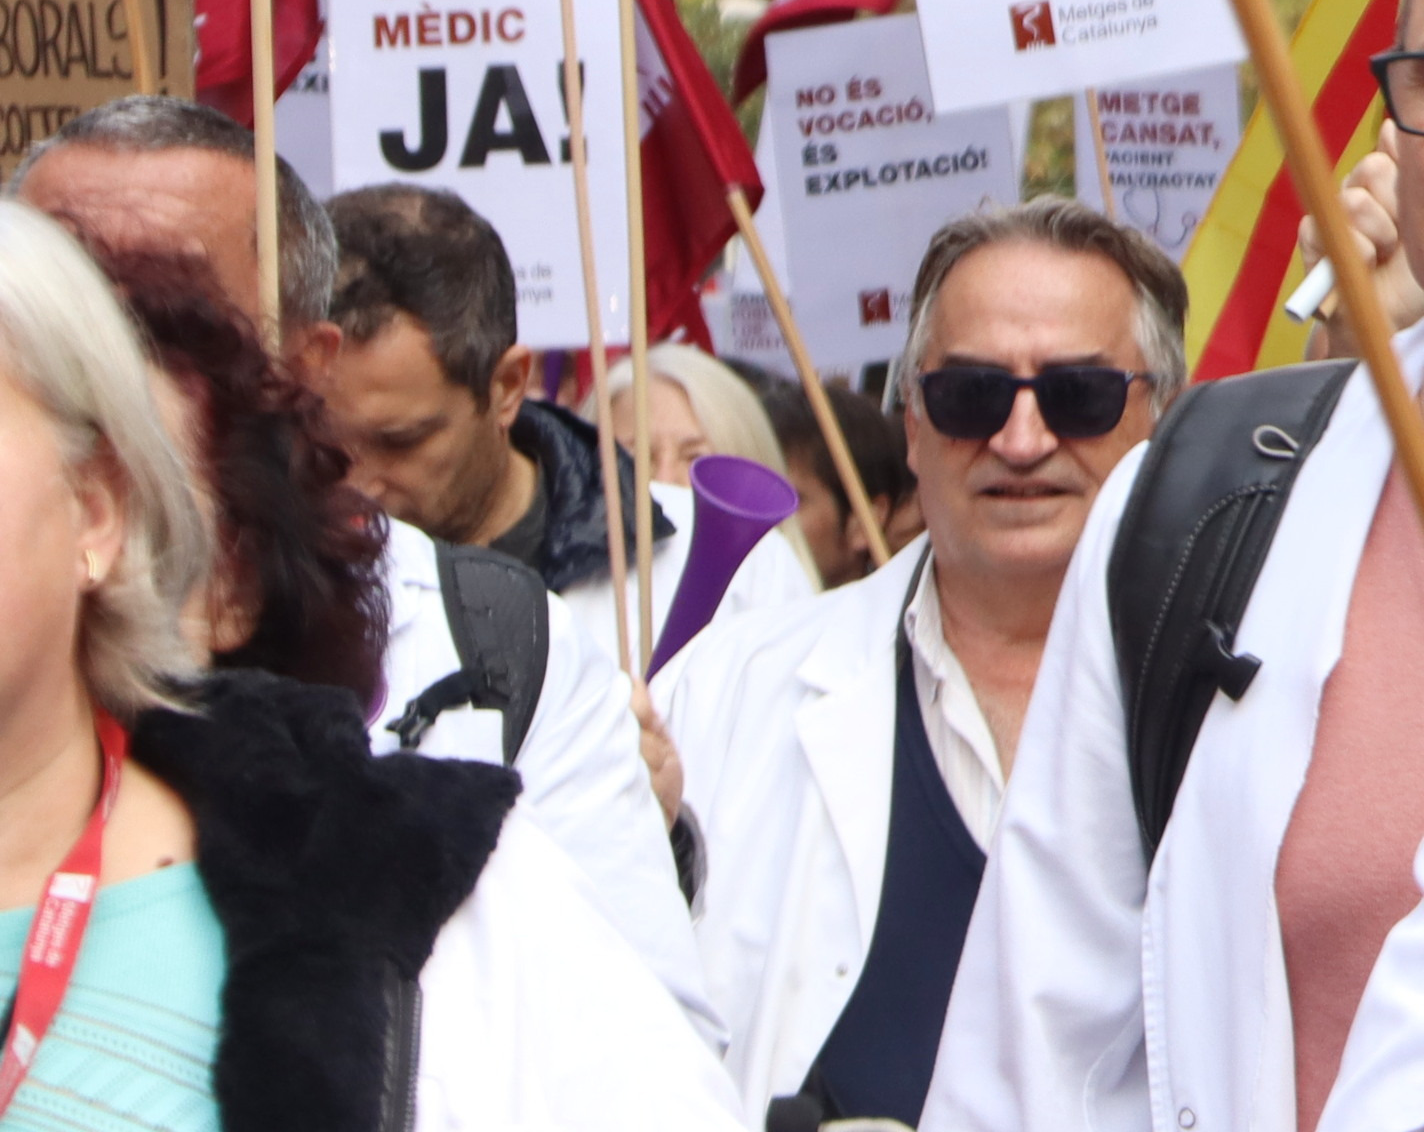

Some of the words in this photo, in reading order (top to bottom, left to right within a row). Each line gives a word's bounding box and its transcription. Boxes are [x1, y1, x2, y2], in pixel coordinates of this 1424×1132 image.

[373, 1, 526, 49] MÈDIC
[796, 84, 836, 108] NO
[845, 74, 882, 103] ÉS
[1099, 91, 1200, 116] METGE
[378, 58, 588, 173] JA!
[798, 95, 934, 137] VOCACIÓ,
[803, 141, 838, 166] ÉS
[1100, 120, 1221, 151] CANSAT,
[805, 143, 988, 196] EXPLOTACIÓ!
